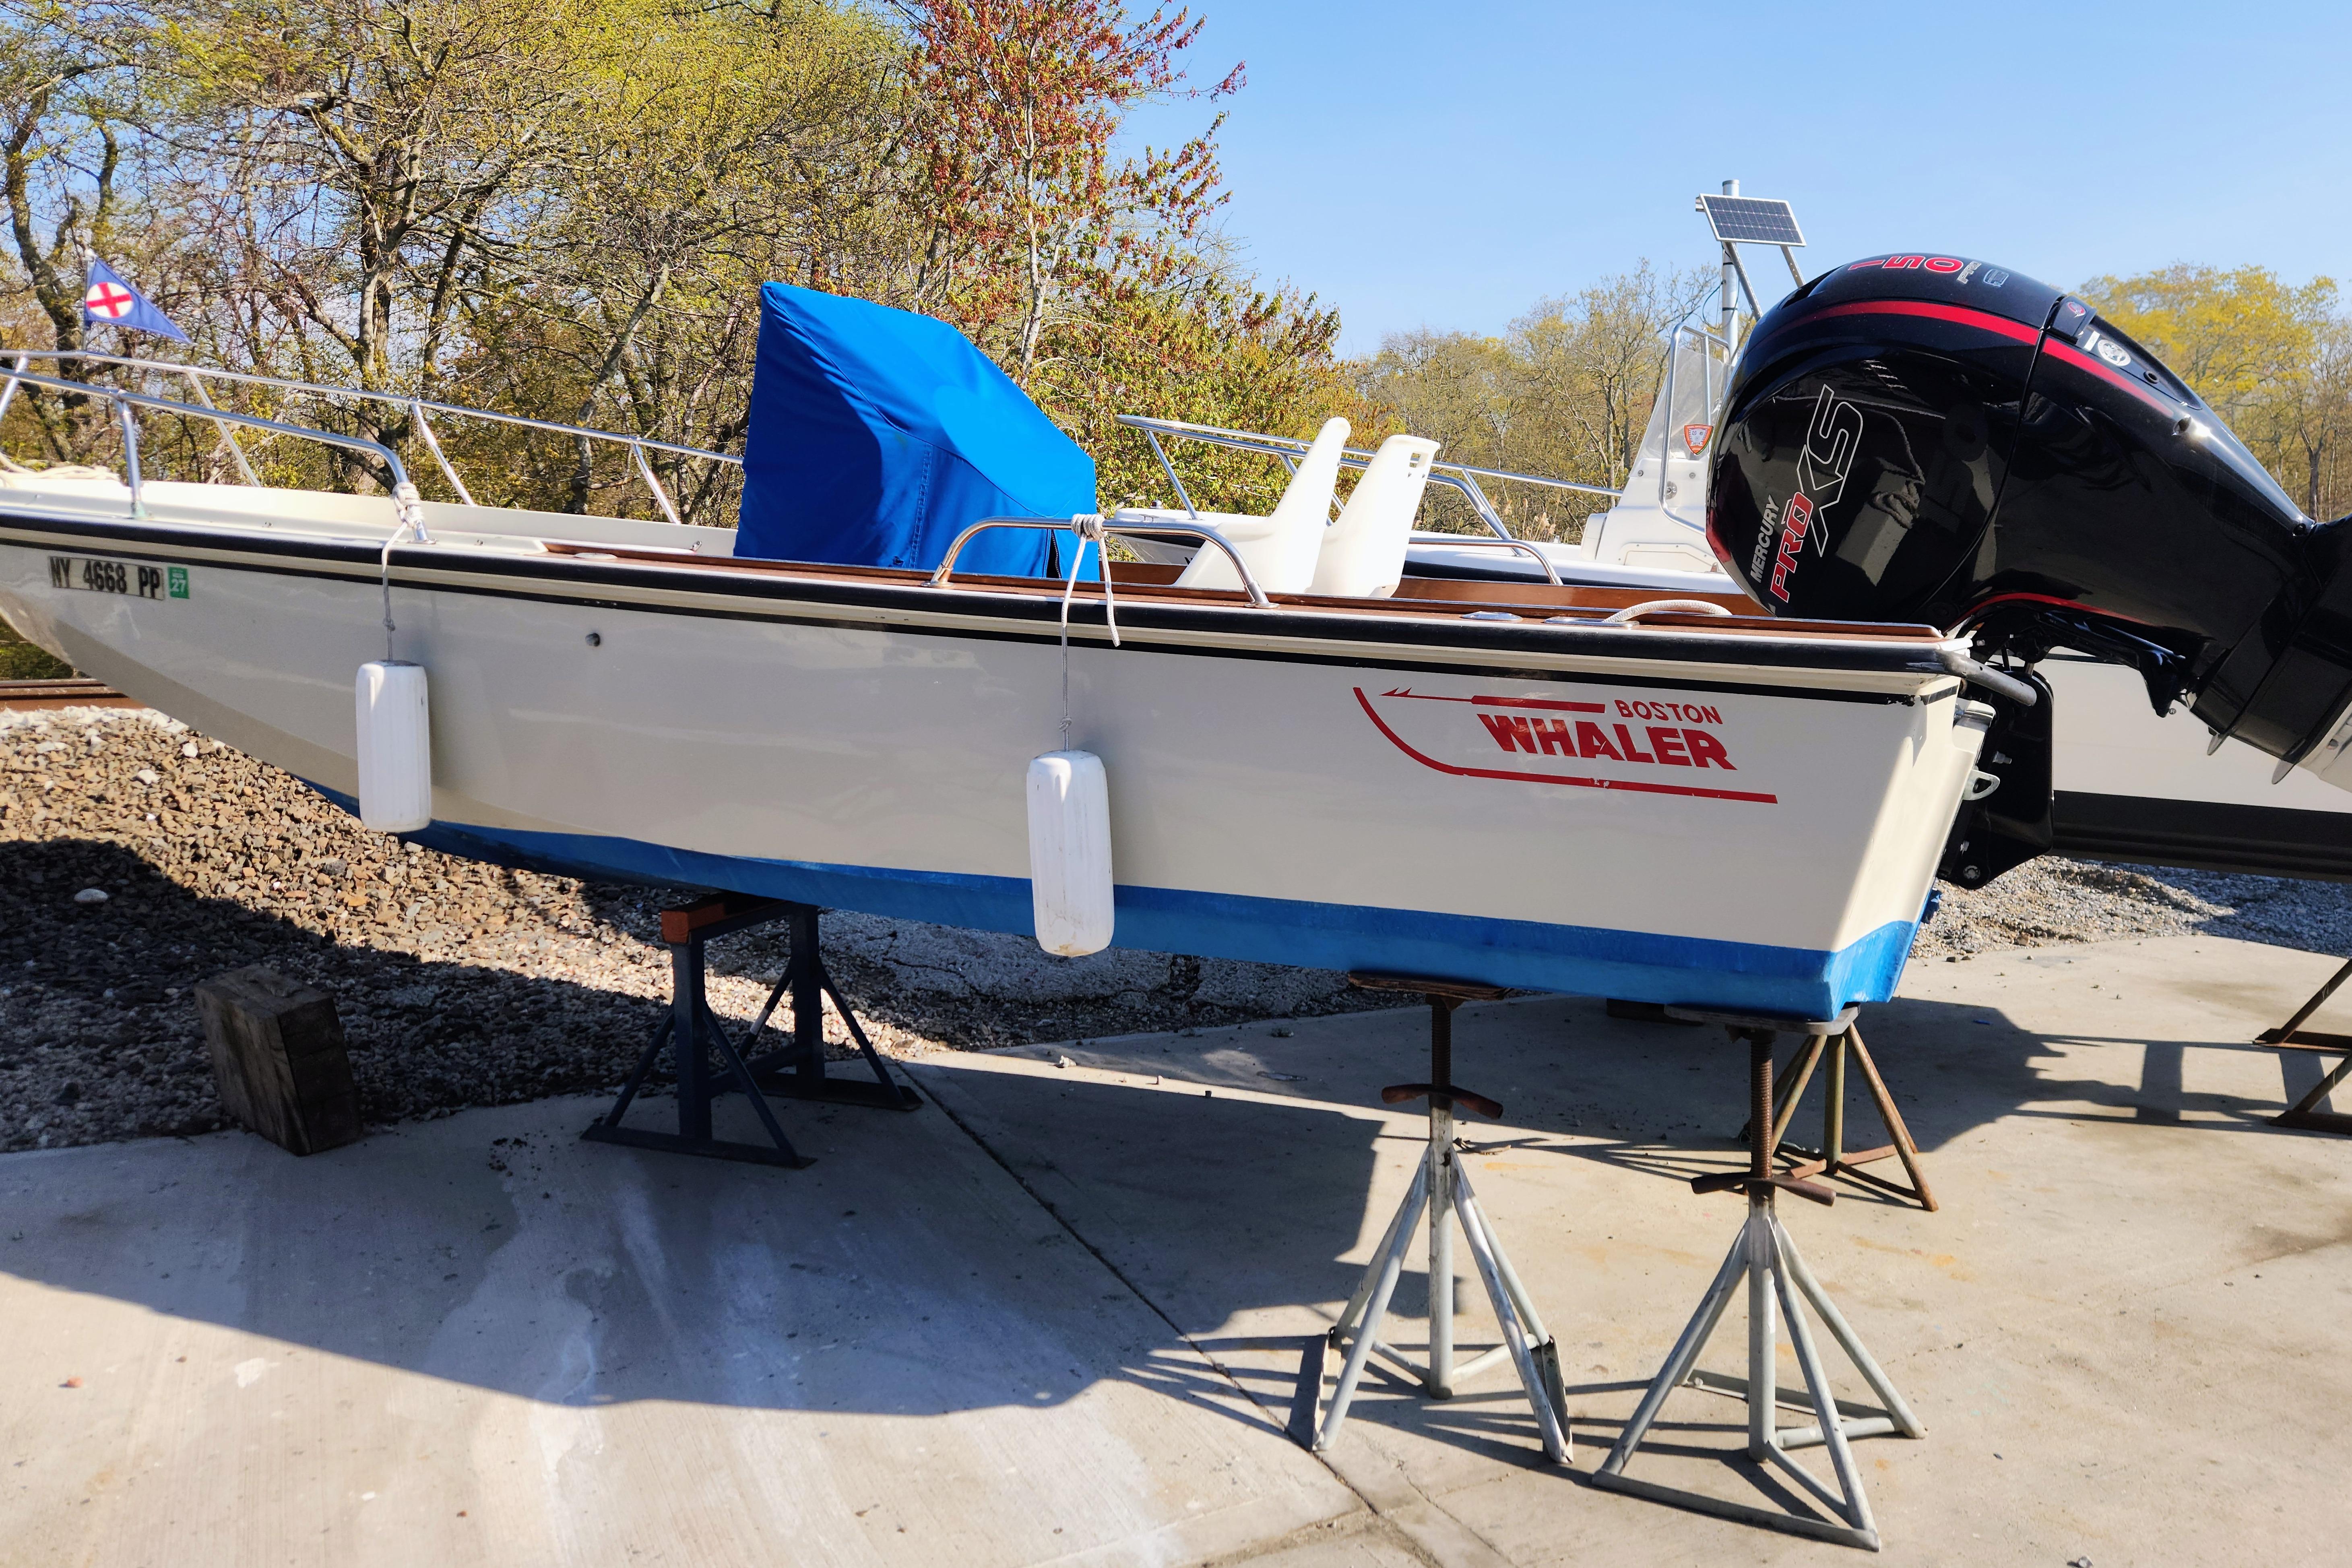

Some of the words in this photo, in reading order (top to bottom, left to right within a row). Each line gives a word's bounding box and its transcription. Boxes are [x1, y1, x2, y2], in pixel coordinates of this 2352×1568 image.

[1848, 255, 1964, 273] 150
[1750, 494, 1780, 583] MERCURY
[50, 558, 70, 588] NY
[83, 560, 127, 594] 4668
[138, 565, 160, 599] PP
[169, 579, 186, 593] 27
[1614, 700, 1723, 724] BOSTON
[1476, 714, 1737, 771] WHALER
